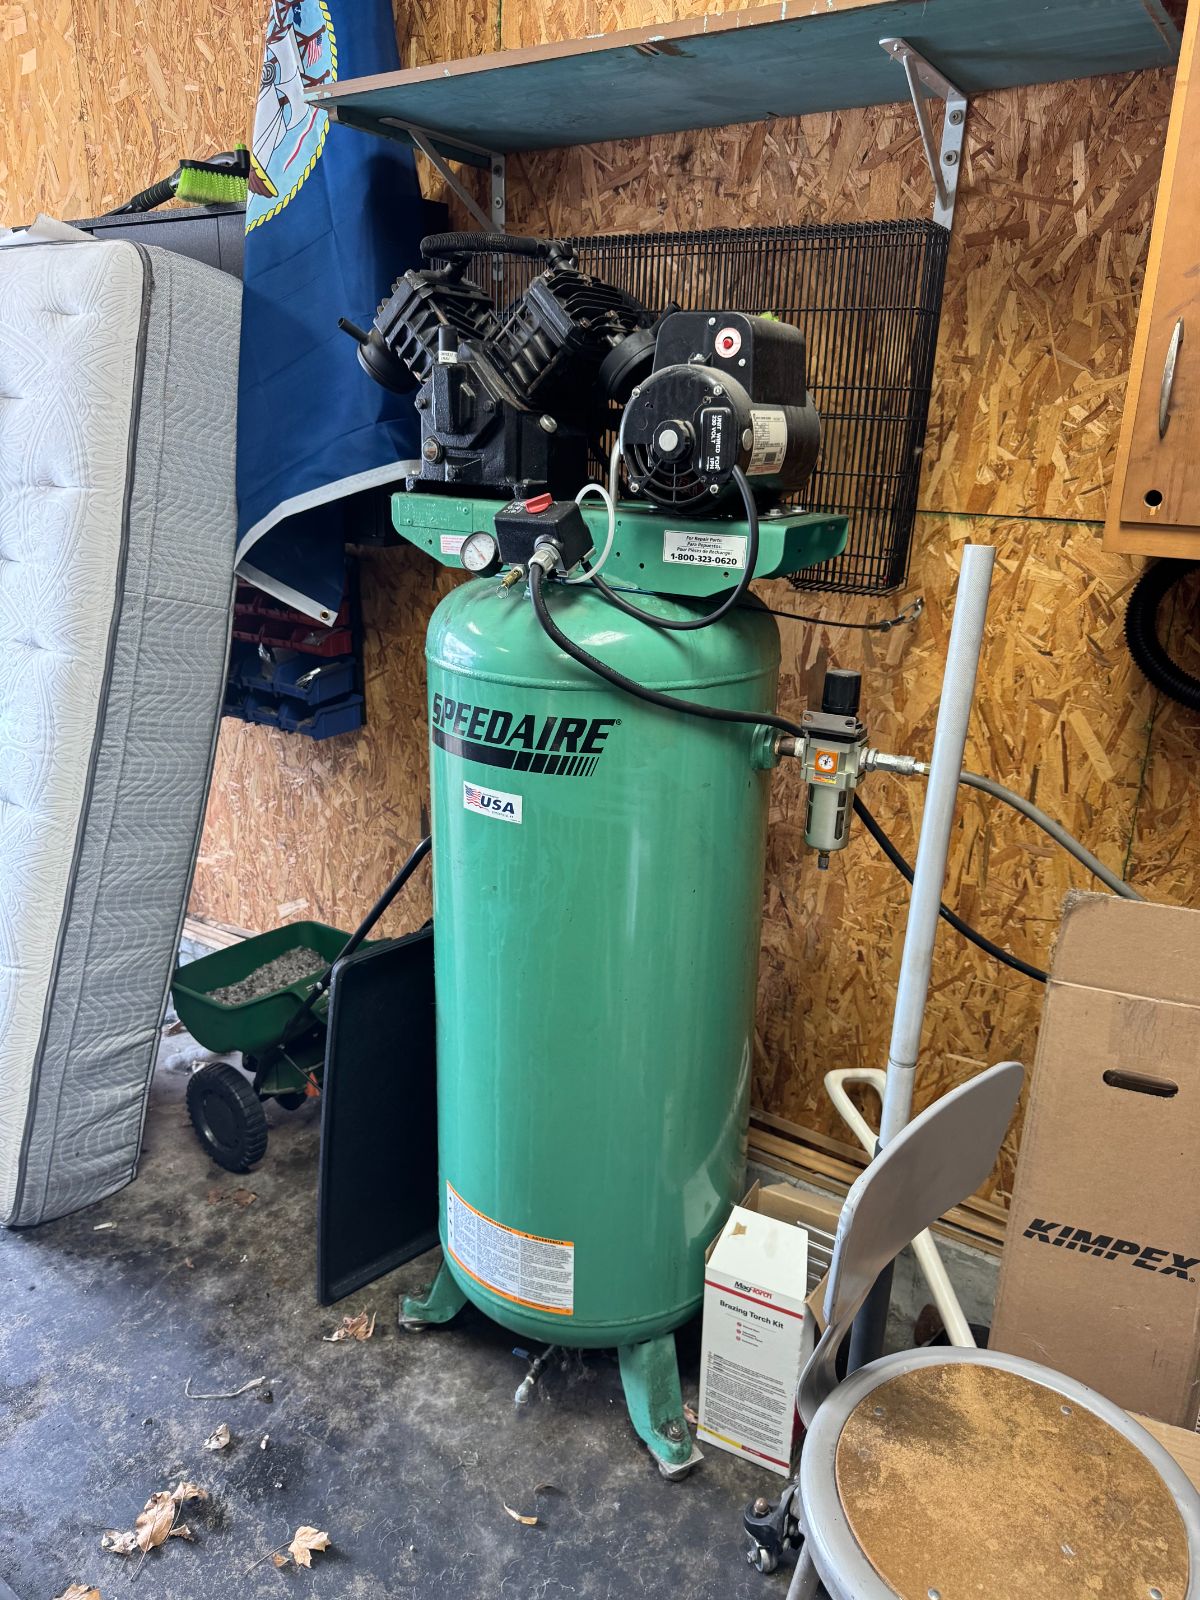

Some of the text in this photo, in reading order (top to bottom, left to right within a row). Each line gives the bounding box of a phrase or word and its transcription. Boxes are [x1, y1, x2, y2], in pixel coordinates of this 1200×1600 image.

[670, 553, 737, 565] 1-800-323-0620
[480, 796, 514, 814] USA
[719, 1300, 784, 1329] Brazing Torch Kit
